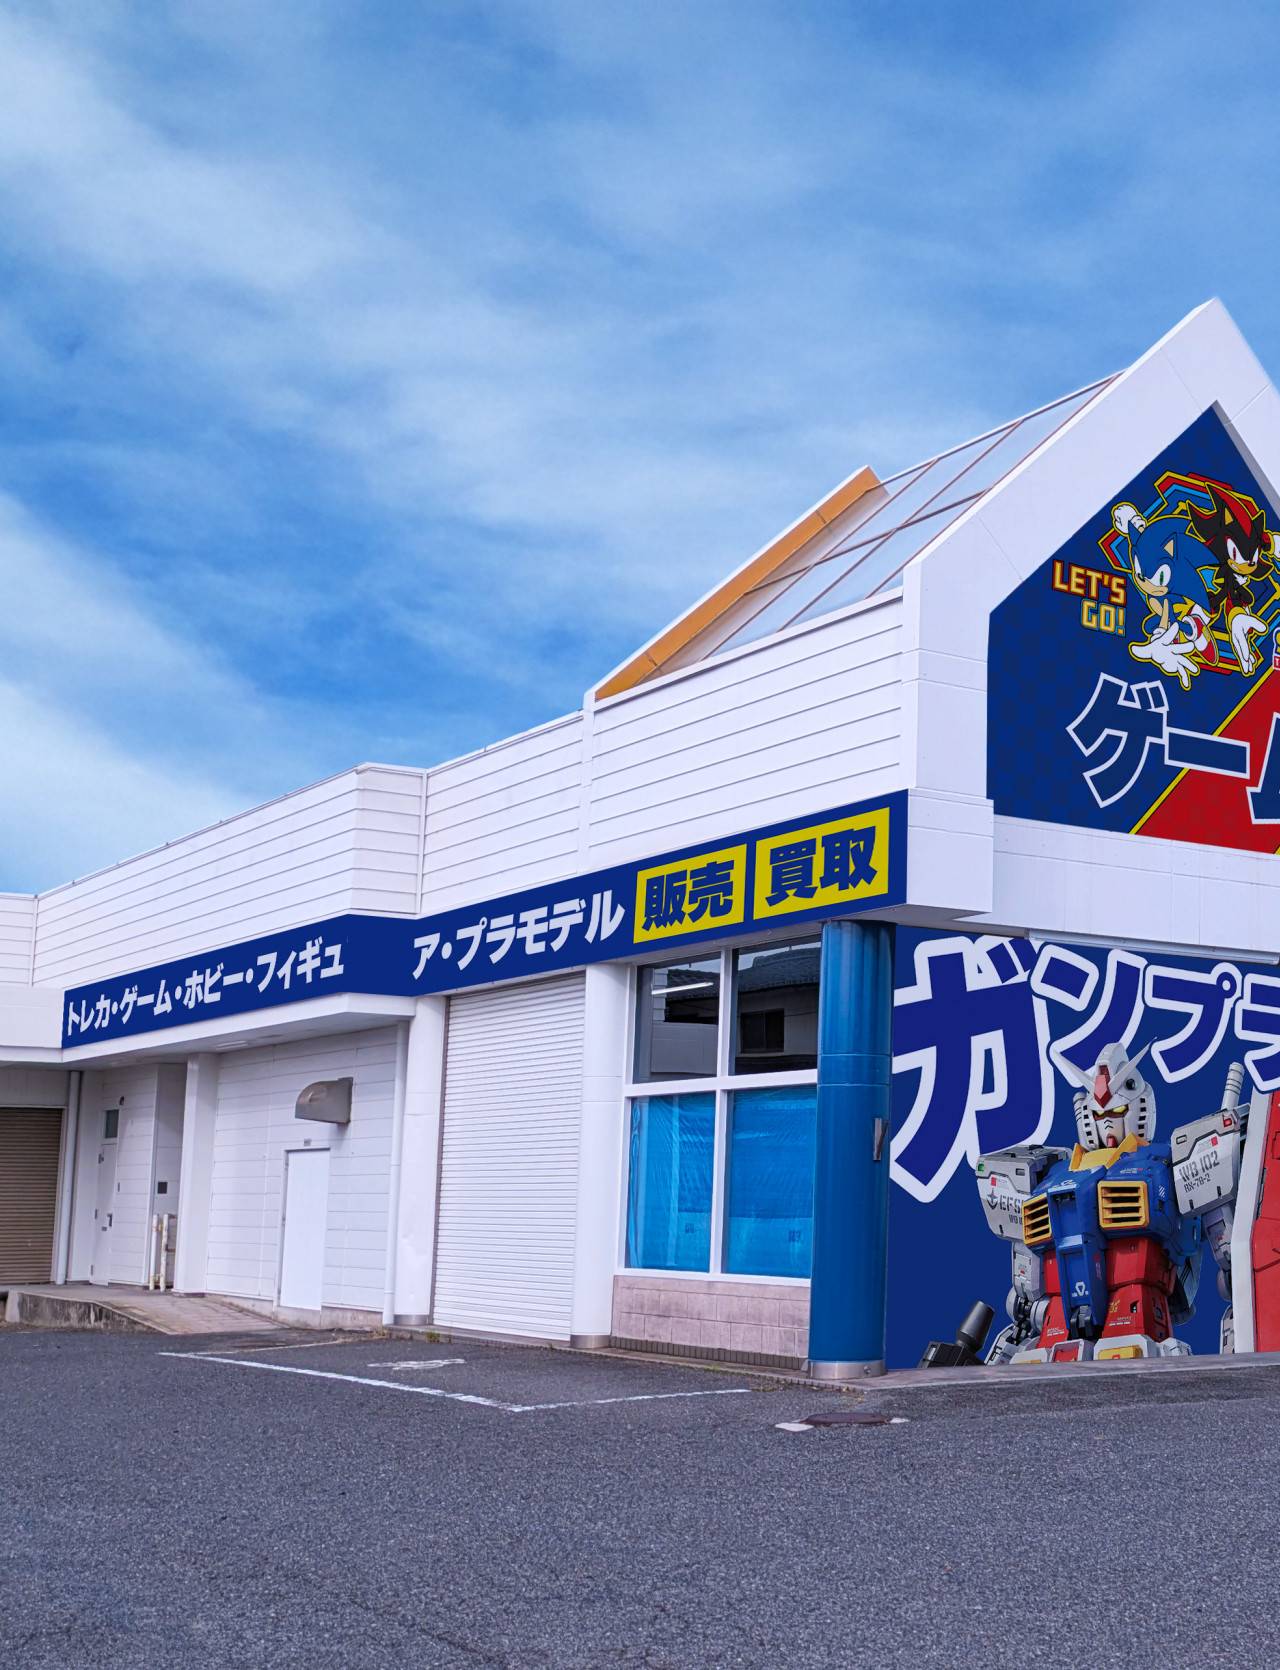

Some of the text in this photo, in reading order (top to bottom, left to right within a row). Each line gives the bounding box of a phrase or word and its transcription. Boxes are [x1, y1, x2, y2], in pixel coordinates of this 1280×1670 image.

[1052, 559, 1127, 607] LET'S
[1081, 598, 1127, 637] GO!
[641, 859, 735, 932] 販売
[764, 824, 878, 907] 買取
